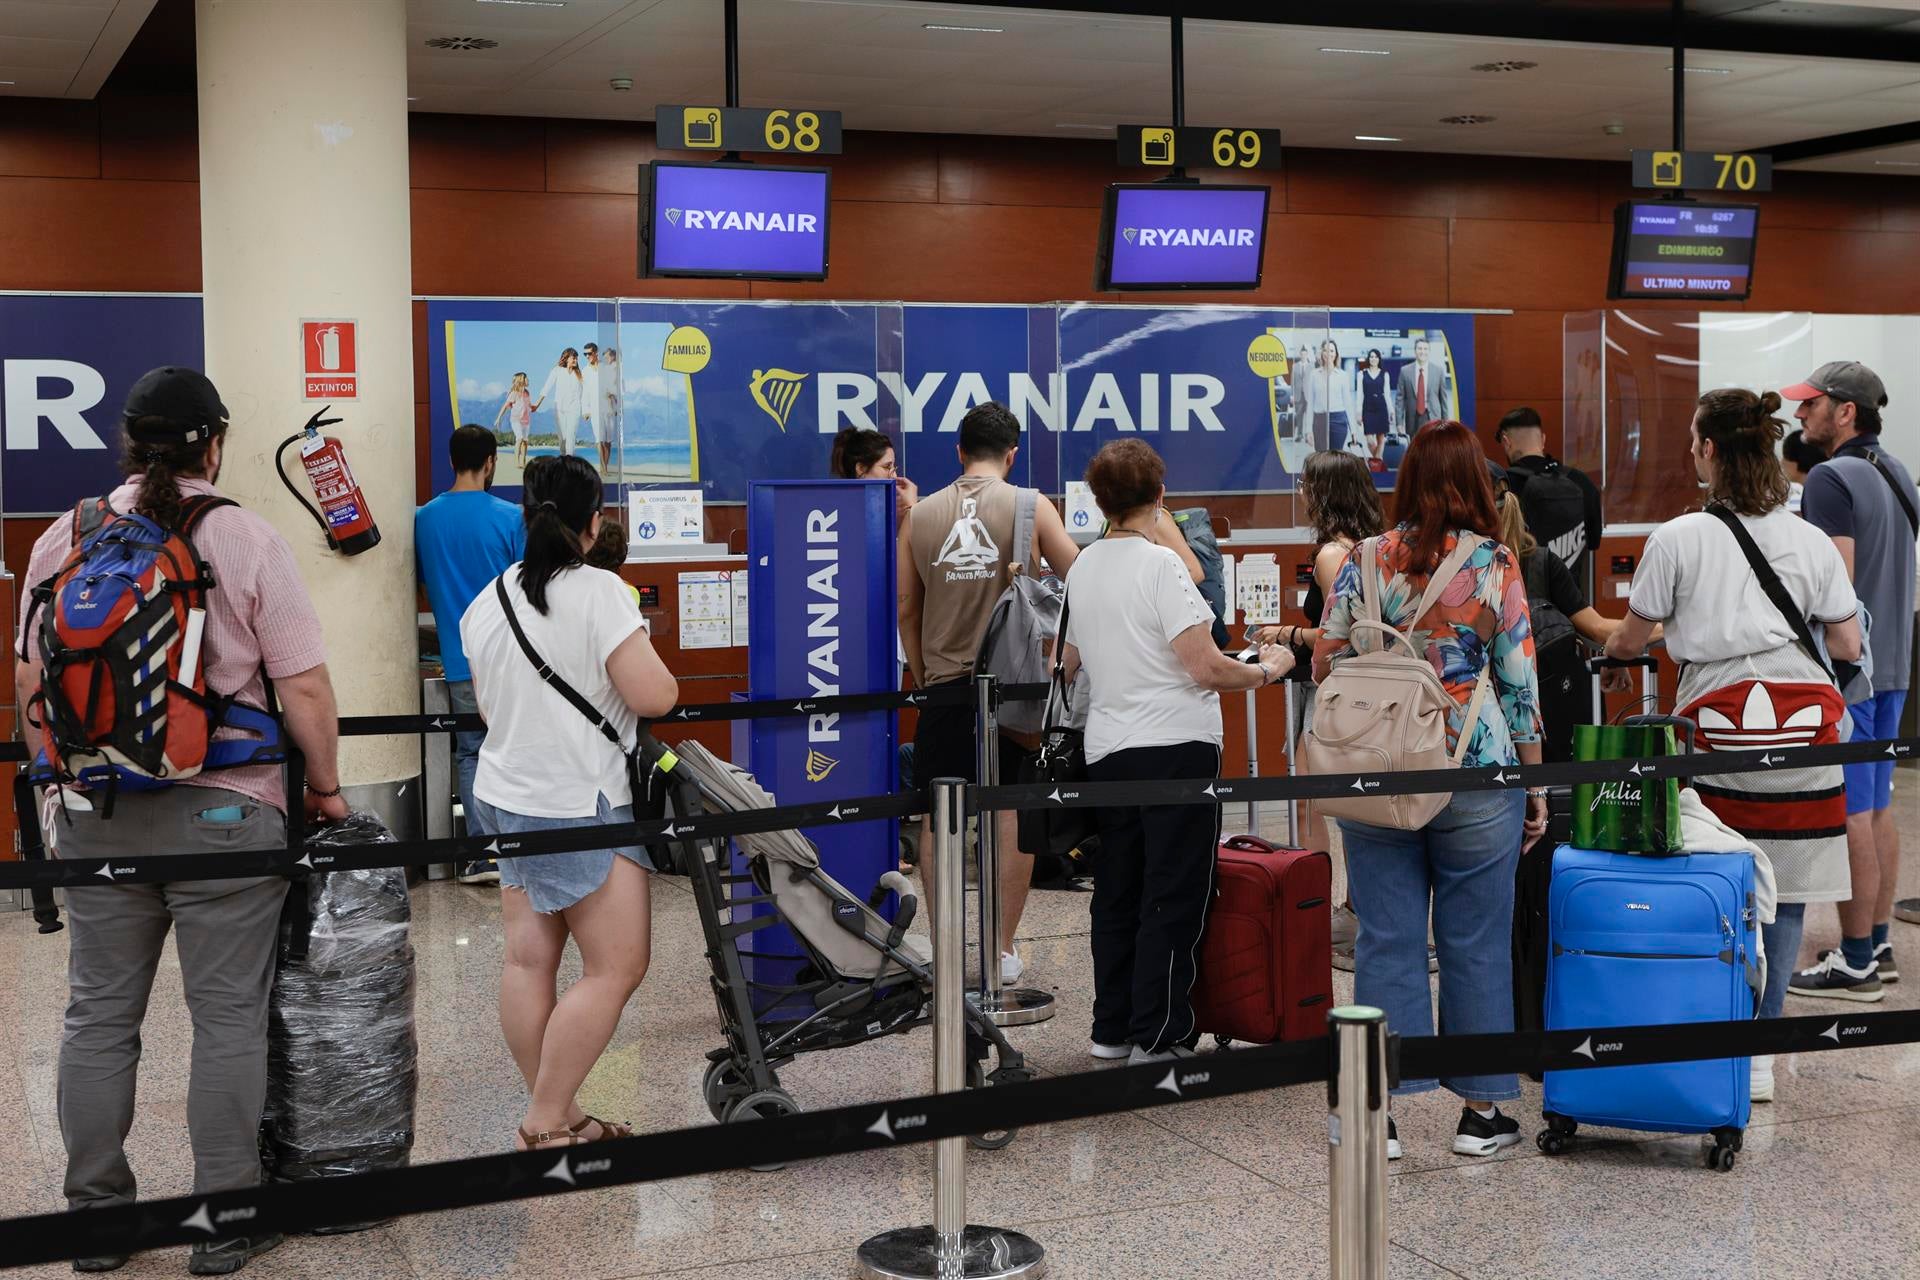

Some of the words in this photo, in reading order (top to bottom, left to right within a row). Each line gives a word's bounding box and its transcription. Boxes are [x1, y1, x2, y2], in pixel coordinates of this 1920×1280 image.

[764, 109, 820, 152] 68
[1212, 128, 1261, 168] 69
[1713, 153, 1757, 191] 70
[684, 209, 817, 233] RYANAIR
[1639, 217, 1676, 225] RYANAIR
[1680, 211, 1693, 220] FR
[1139, 228, 1255, 246] RYANAIR
[1658, 244, 1724, 257] EDIMBURGO
[1643, 277, 1685, 289] ULTIMO
[1687, 279, 1731, 290] MINUTO
[668, 345, 706, 356] FAMILIAS
[1250, 351, 1284, 362] NEGOCIOS
[308, 383, 354, 392] EXTINTOR
[1548, 520, 1586, 560] NIKE
[1590, 781, 1642, 811] Júlia
[1841, 1026, 1867, 1035] aena
[1596, 1042, 1623, 1052] aena
